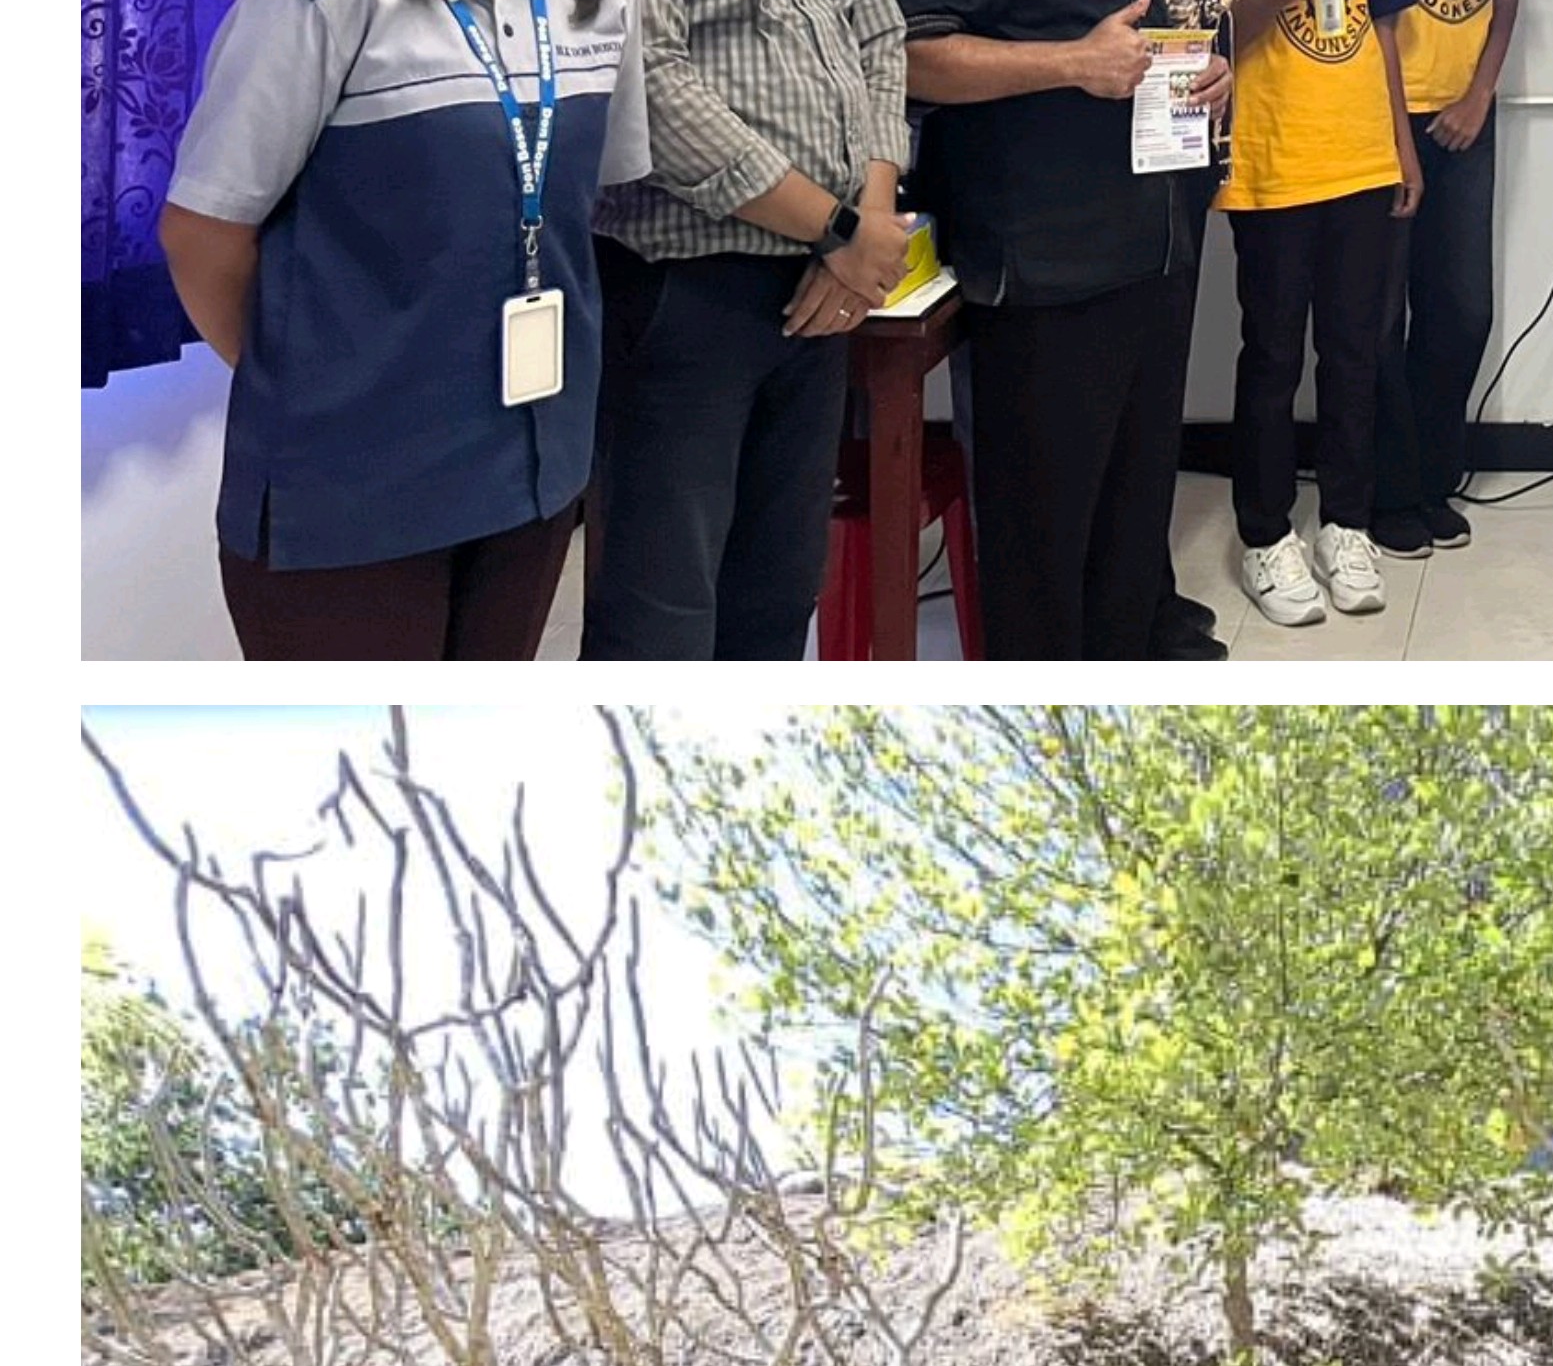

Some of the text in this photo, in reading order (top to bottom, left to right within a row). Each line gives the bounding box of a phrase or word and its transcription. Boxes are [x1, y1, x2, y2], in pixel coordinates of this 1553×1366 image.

[1286, 3, 1367, 53] INDONESIA
[539, 107, 553, 138] Don
[512, 117, 534, 193] Don Bosco
